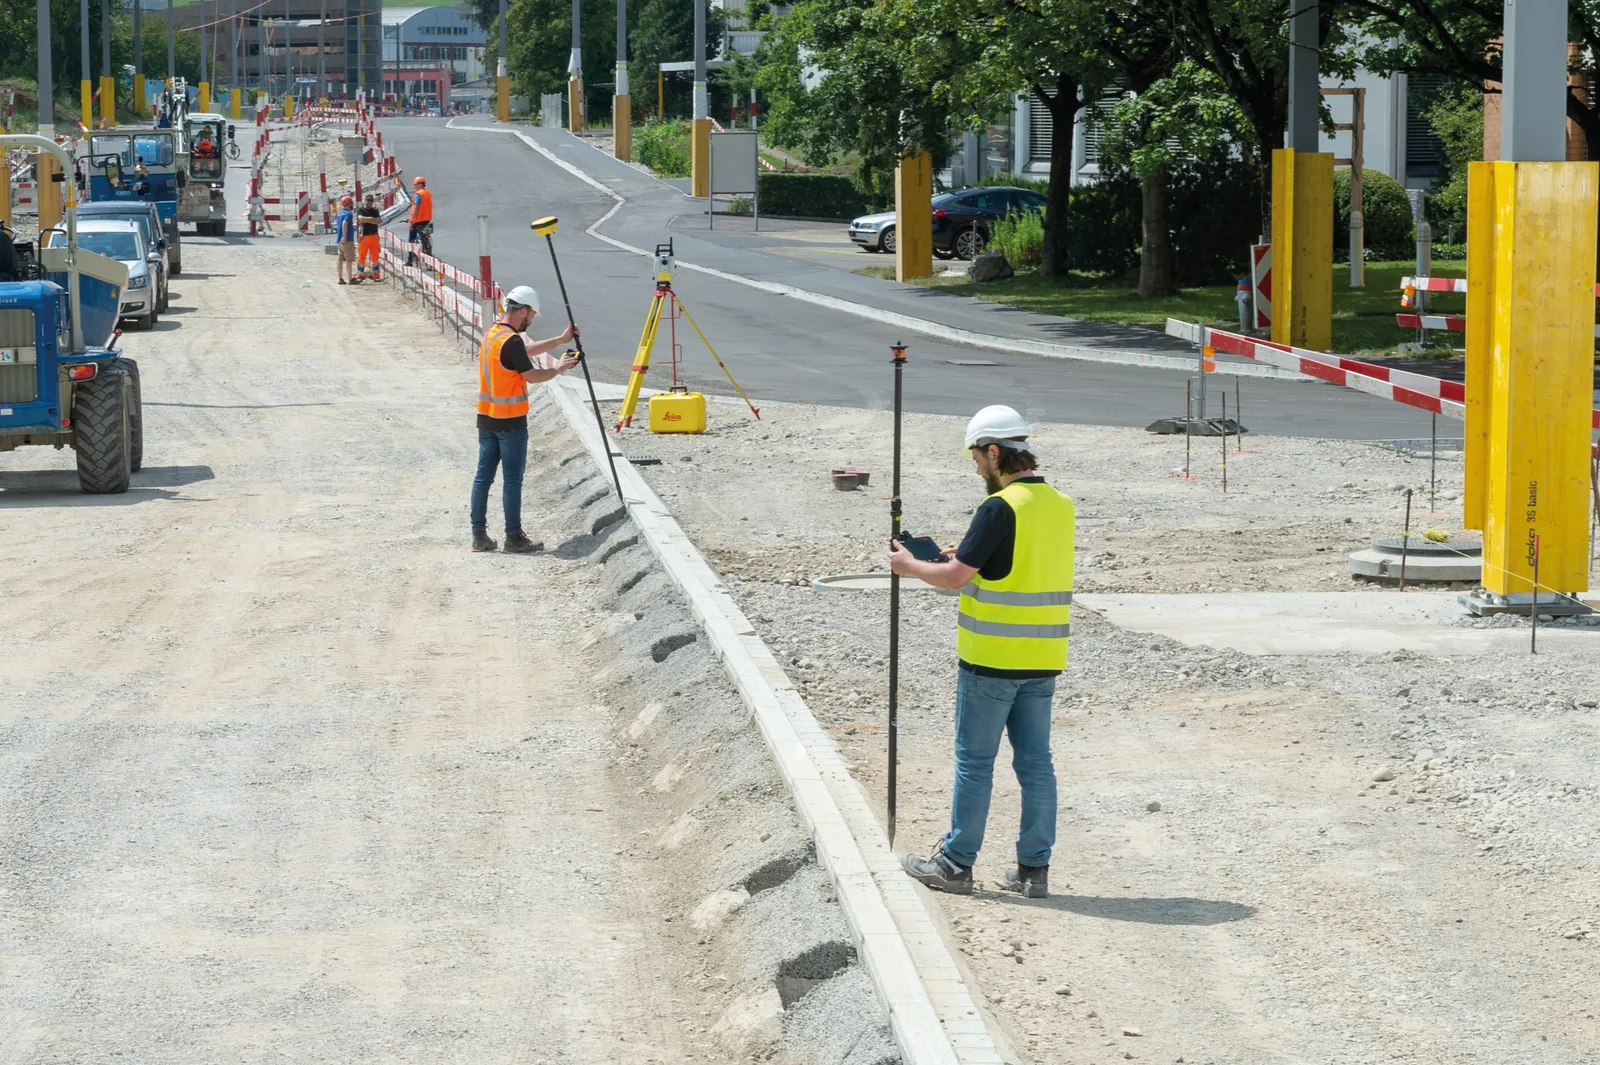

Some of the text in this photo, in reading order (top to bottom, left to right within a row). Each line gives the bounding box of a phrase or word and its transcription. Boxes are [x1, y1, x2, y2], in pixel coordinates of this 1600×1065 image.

[662, 411, 682, 422] Leica
[1525, 480, 1538, 567] doka 3S basic
